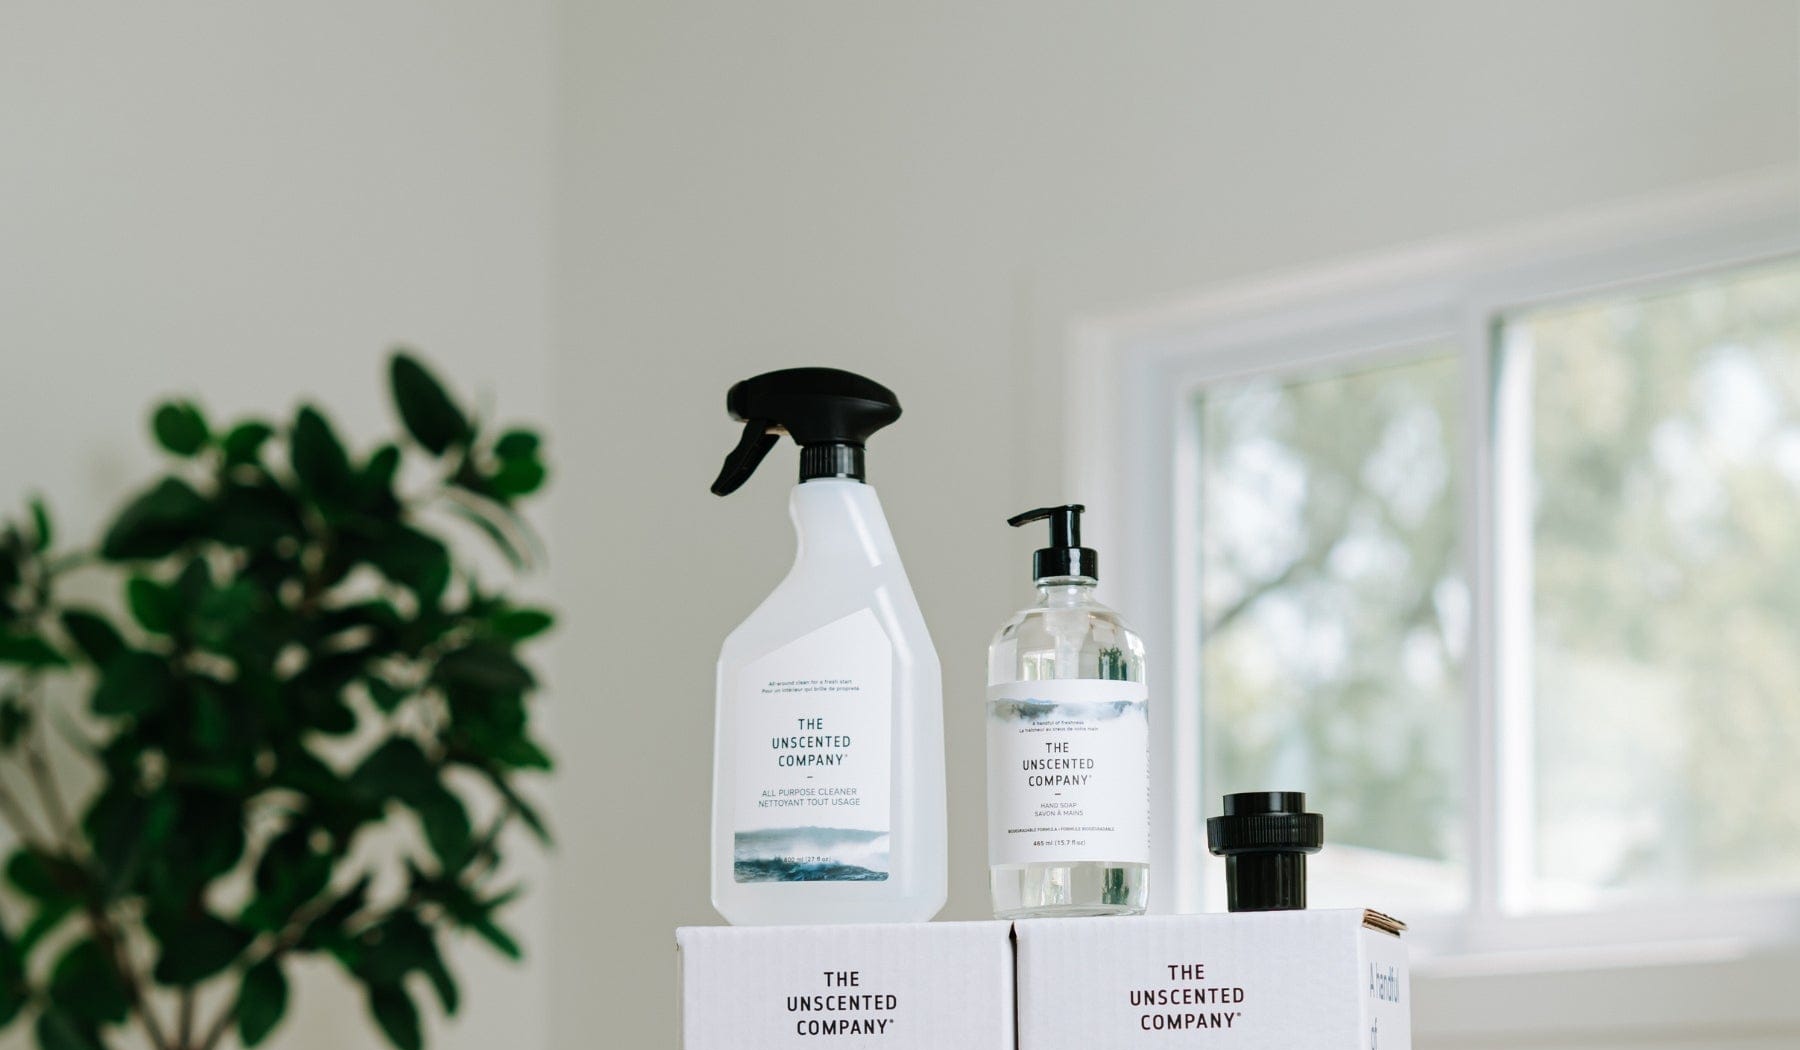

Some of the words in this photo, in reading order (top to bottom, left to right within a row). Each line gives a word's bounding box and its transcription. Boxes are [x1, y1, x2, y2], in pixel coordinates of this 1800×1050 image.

[798, 718, 824, 731] THE
[772, 735, 851, 749] UNSCENTED
[1045, 742, 1069, 753] THE
[1022, 758, 1094, 771] UNSCENTED
[762, 790, 776, 798] ALL
[778, 788, 816, 797] PURPOSE
[818, 788, 857, 796] CLEANER
[758, 799, 804, 808] NETTOYANT
[807, 798, 829, 806] TOUT
[831, 798, 861, 806] USAGE
[1168, 964, 1205, 980] THE
[824, 971, 860, 987] THE
[787, 994, 897, 1012] UNSCENTED
[1130, 987, 1245, 1006] UNSCENTED
